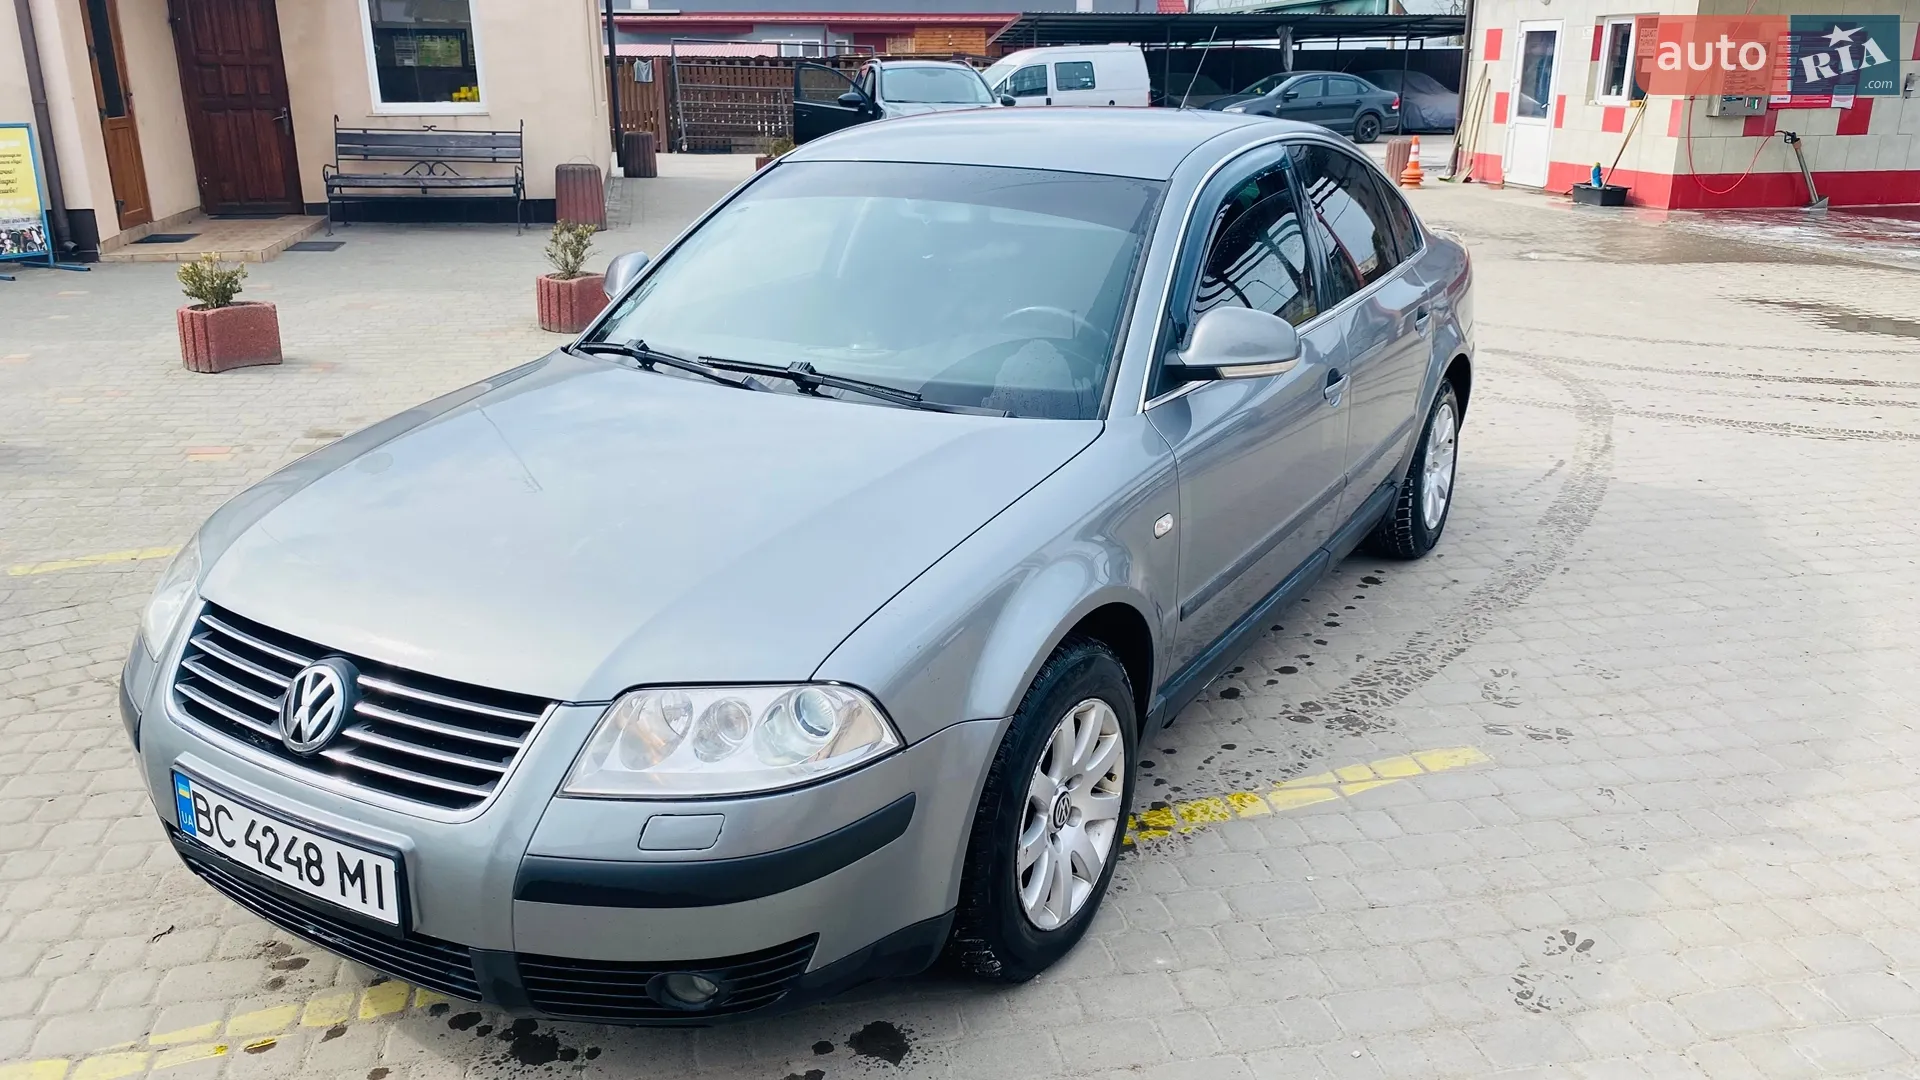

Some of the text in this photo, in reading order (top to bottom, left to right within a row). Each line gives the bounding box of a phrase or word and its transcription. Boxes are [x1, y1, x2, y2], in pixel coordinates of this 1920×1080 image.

[181, 810, 195, 829] UA
[192, 789, 385, 911] BC 4248 MI
